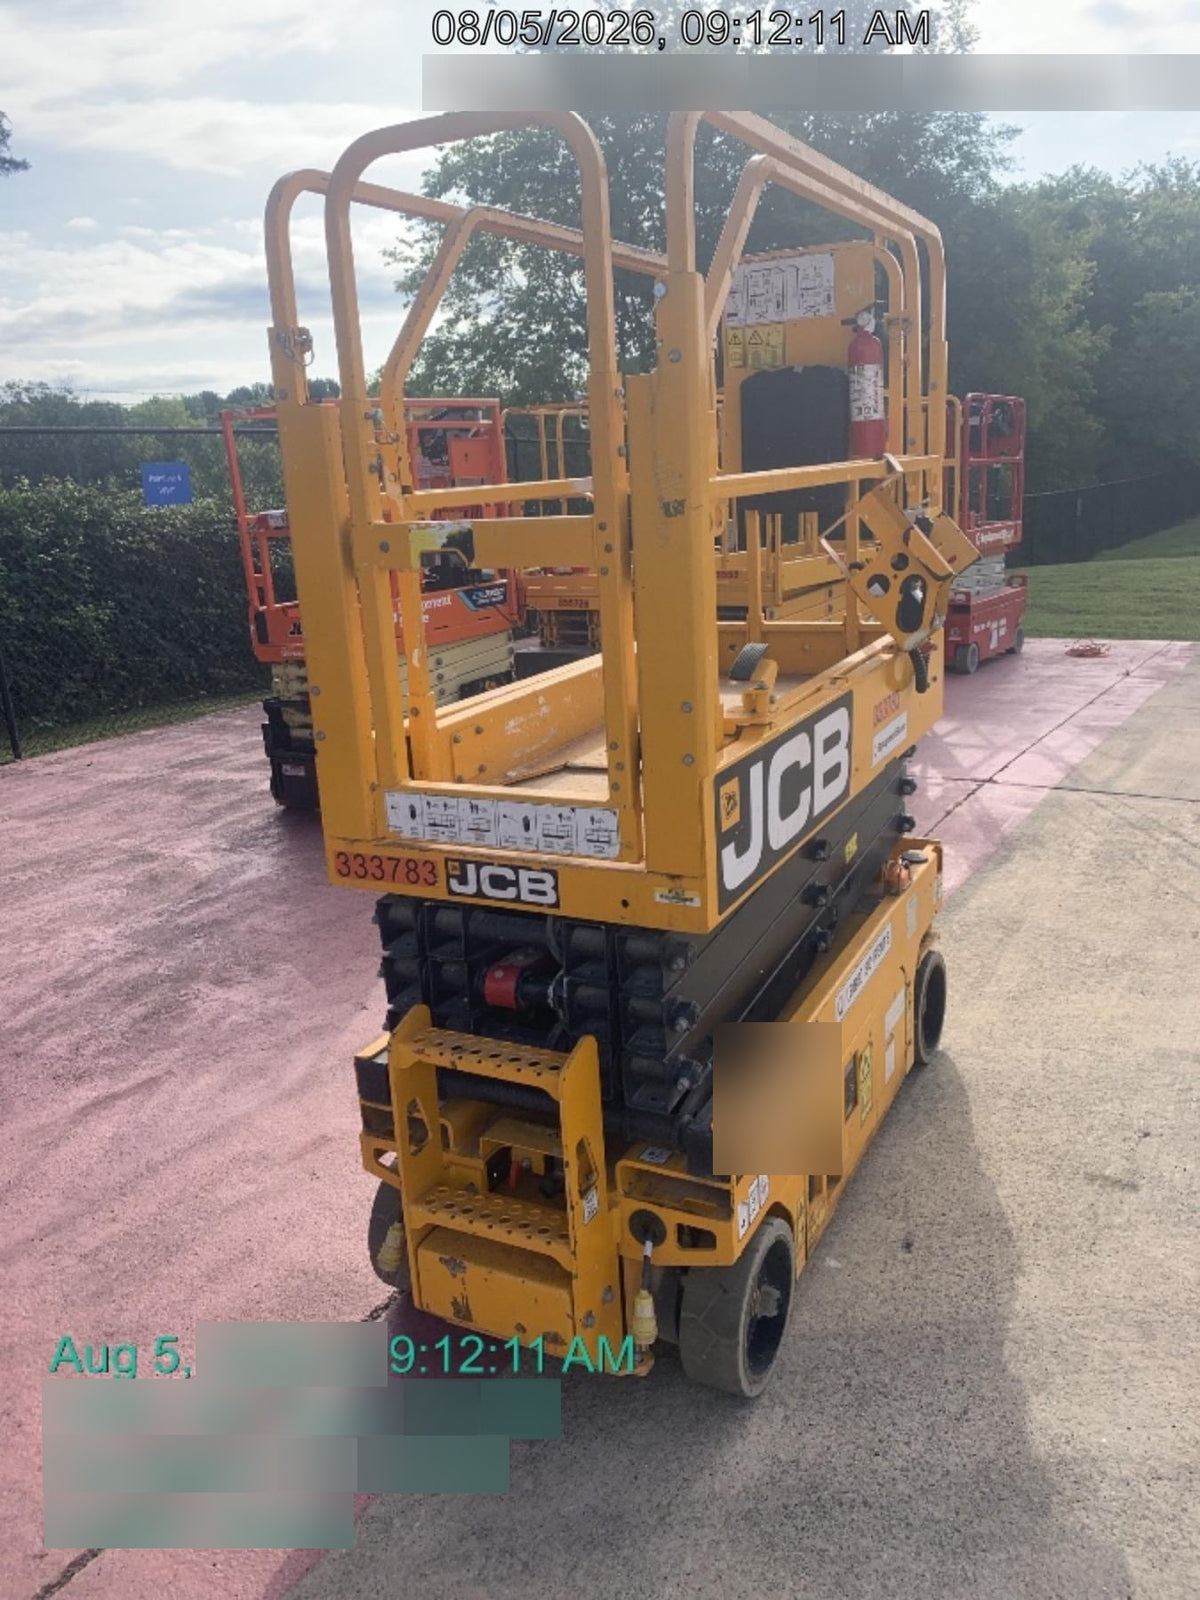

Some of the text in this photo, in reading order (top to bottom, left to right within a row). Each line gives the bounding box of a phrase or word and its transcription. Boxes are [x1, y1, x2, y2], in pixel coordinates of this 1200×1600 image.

[720, 707, 851, 891] JCB
[335, 851, 438, 887] 333783
[449, 862, 558, 905] JCB
